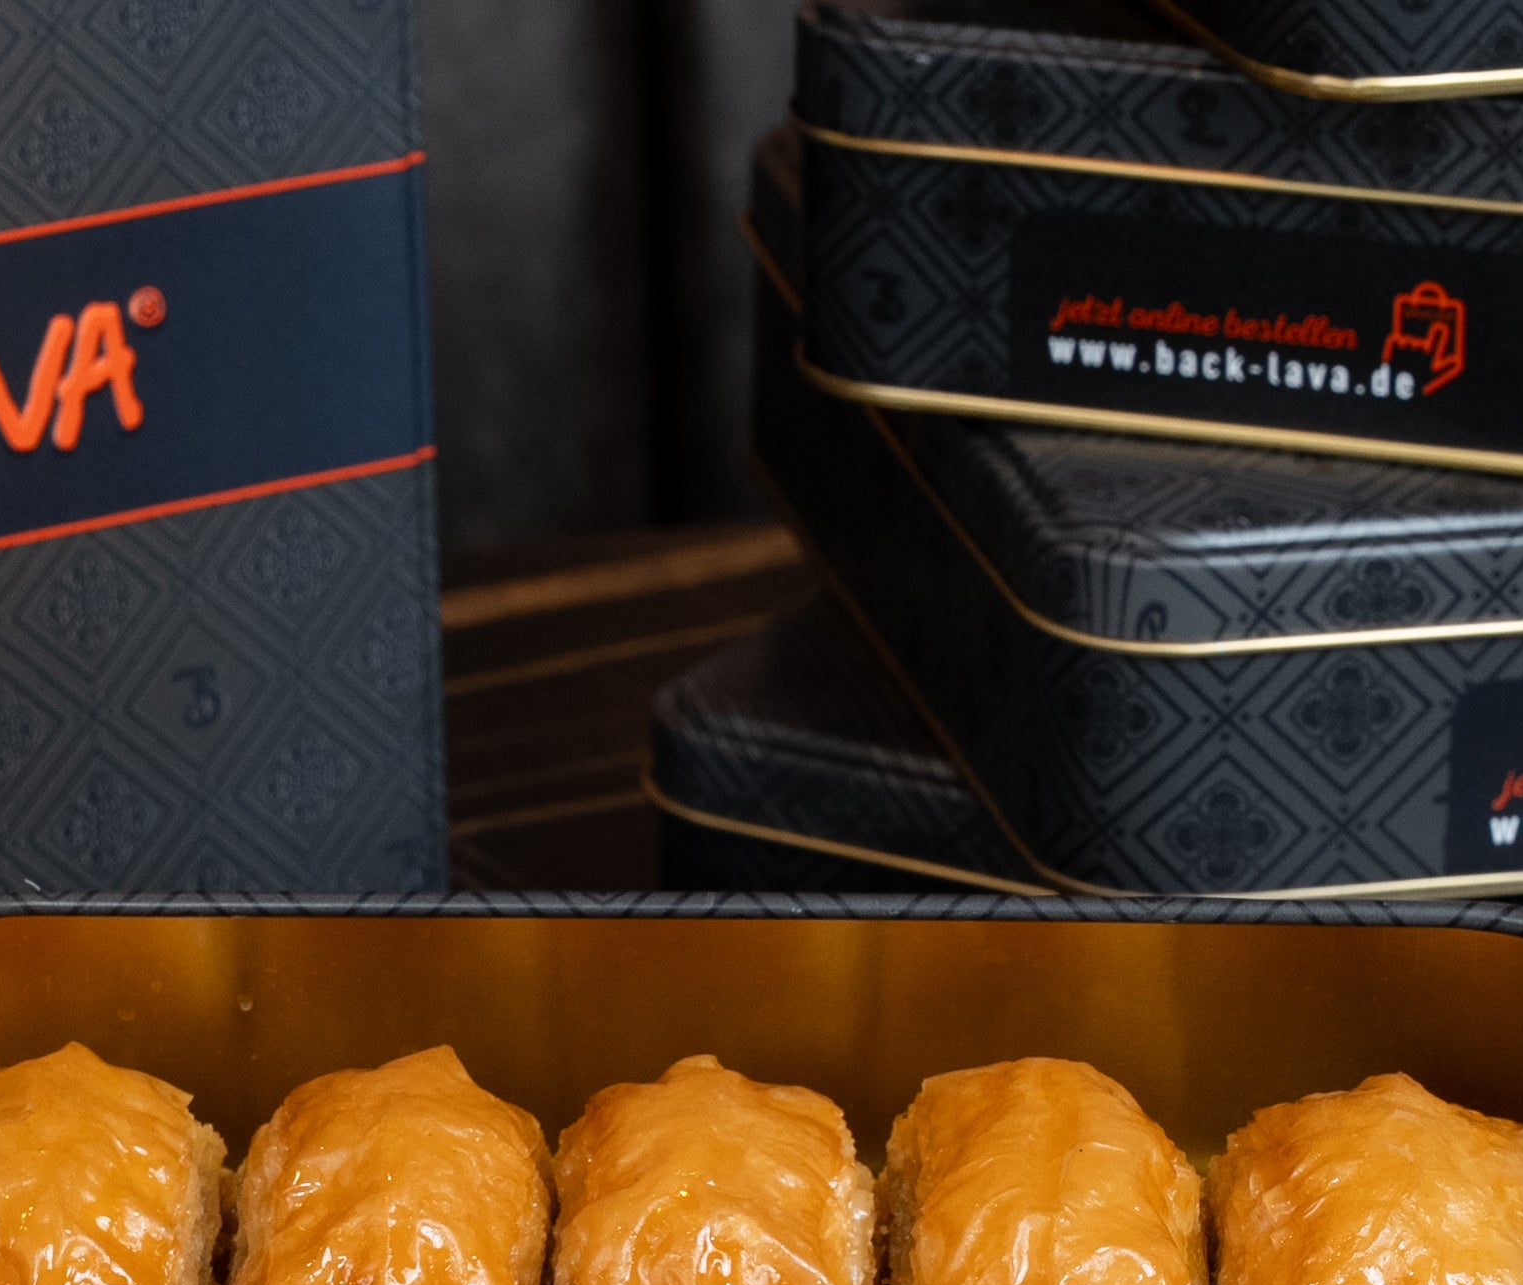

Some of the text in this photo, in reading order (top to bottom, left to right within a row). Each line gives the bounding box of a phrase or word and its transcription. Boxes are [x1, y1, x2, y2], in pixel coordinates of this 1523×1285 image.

[1050, 294, 1358, 350] jetzt online bestellen
[1047, 335, 1416, 400] www.back-lava.de
